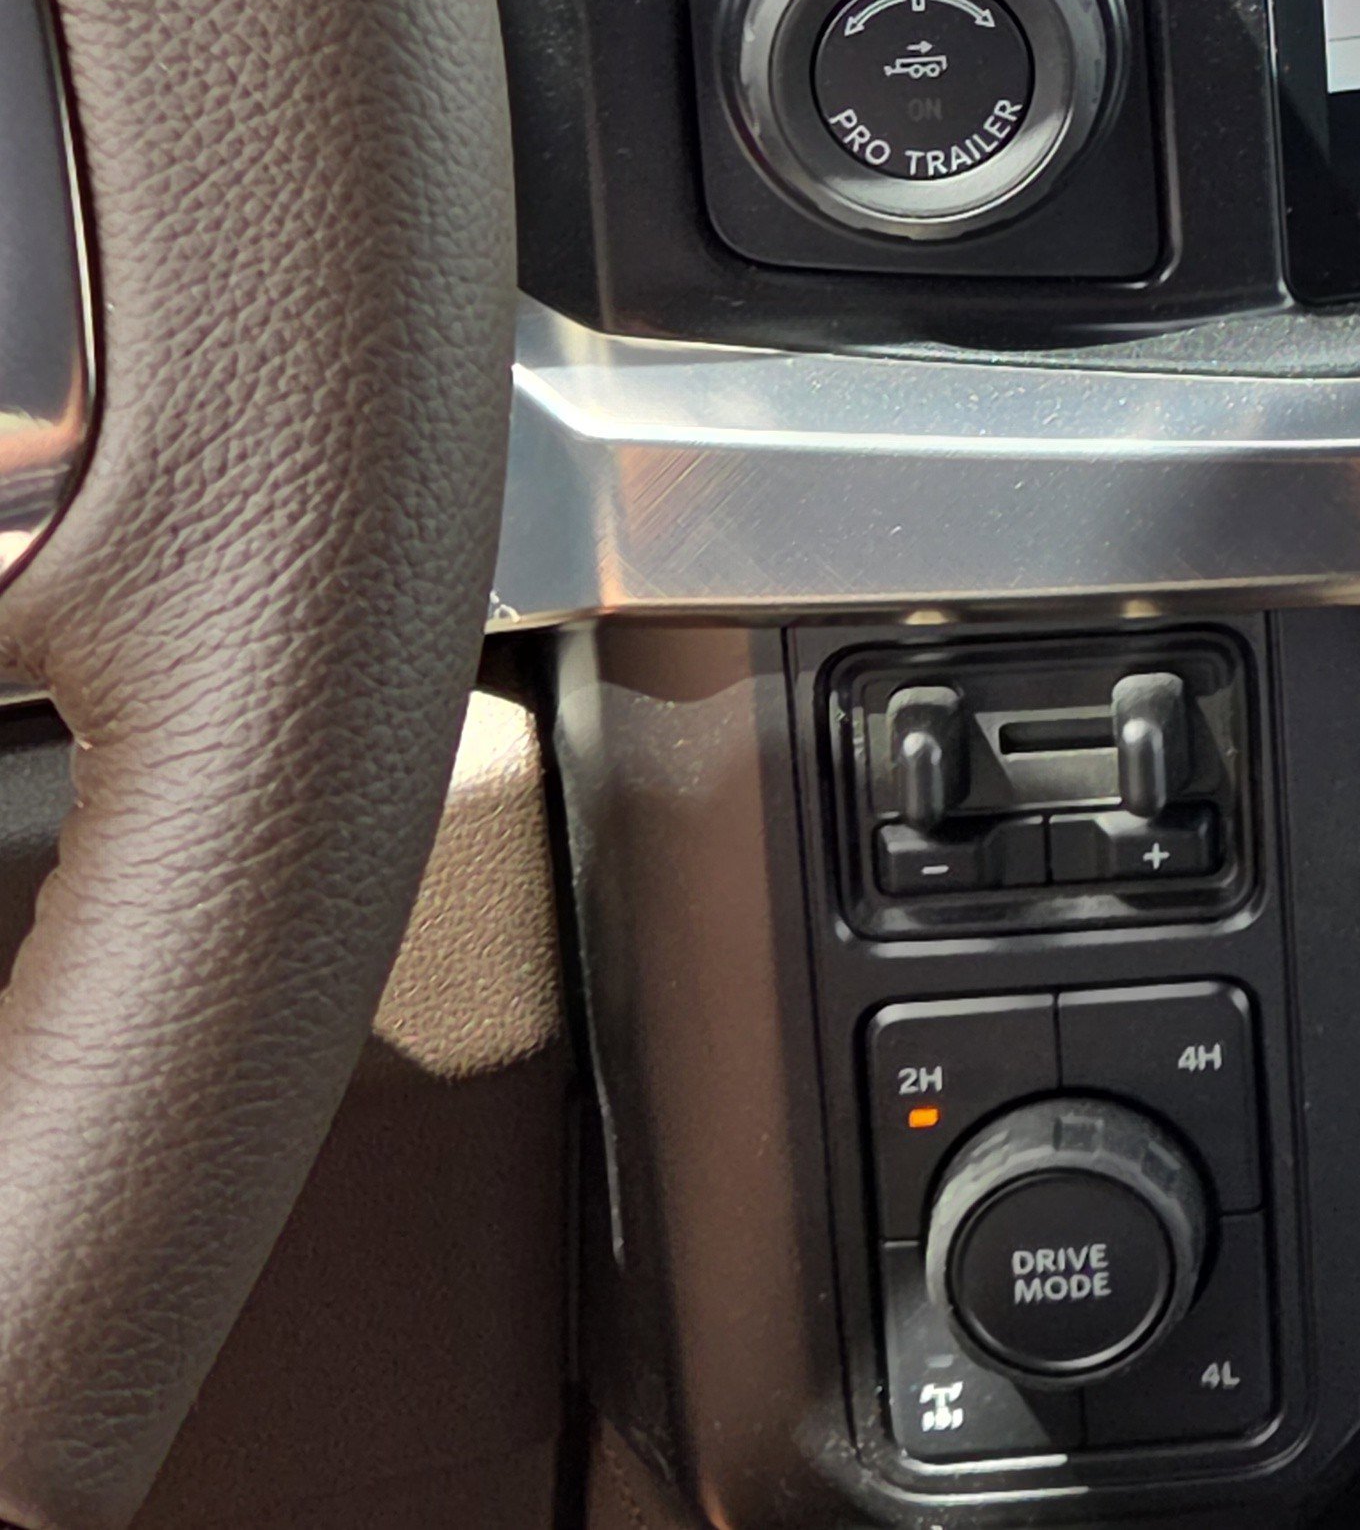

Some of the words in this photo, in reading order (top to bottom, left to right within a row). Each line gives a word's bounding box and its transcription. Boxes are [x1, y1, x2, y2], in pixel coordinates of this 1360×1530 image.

[829, 107, 892, 167] PRO
[904, 97, 1024, 177] TRAILER
[1177, 1042, 1223, 1072] 4H
[898, 1066, 943, 1095] 2H
[1011, 1242, 1110, 1276] DRIVE
[1013, 1271, 1112, 1306] MODE
[1200, 1361, 1241, 1389] 4L
